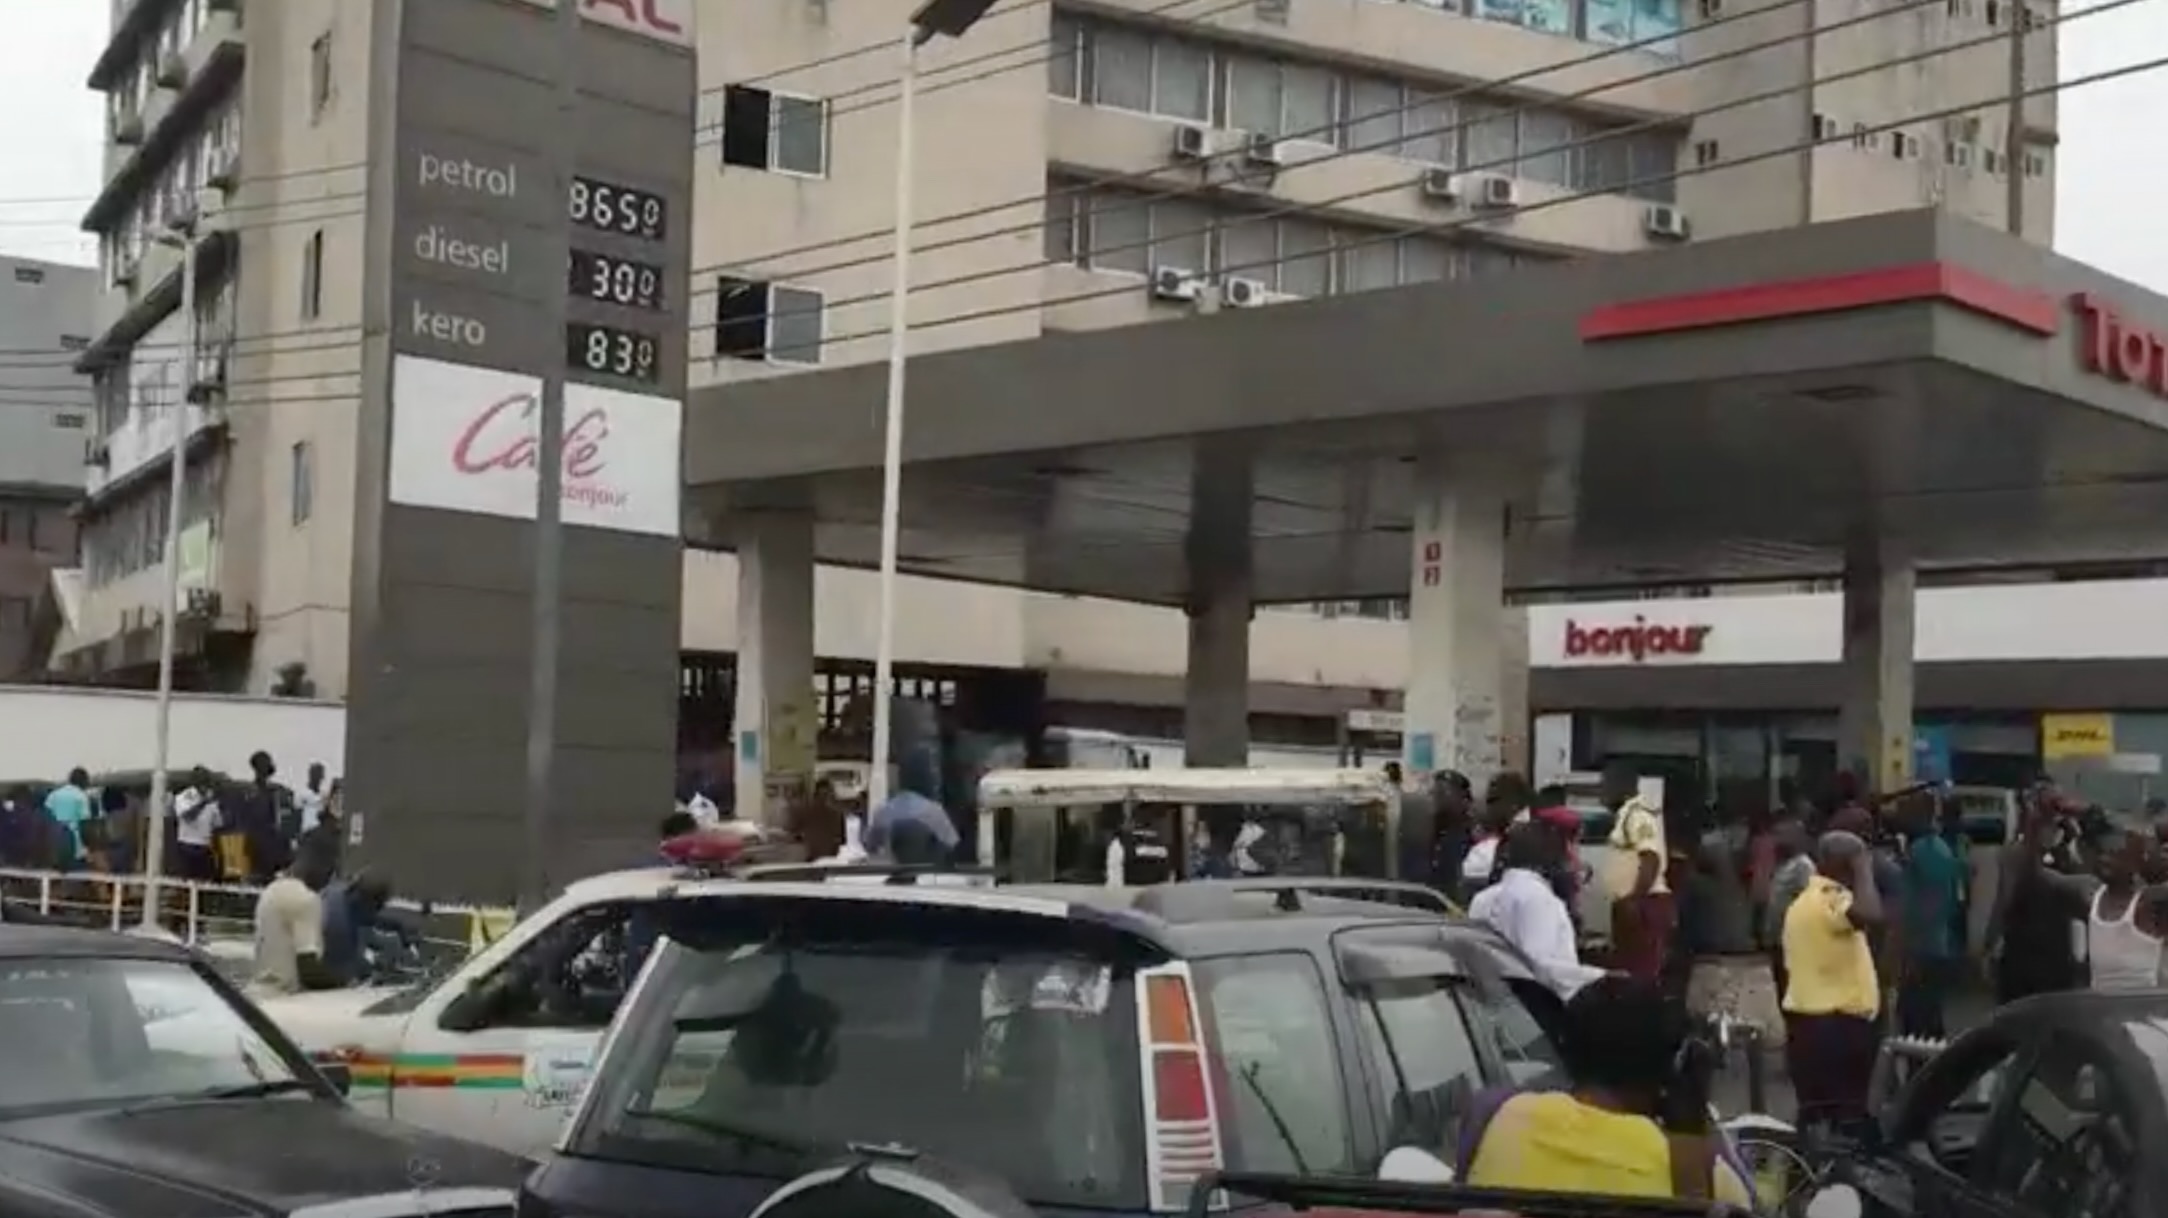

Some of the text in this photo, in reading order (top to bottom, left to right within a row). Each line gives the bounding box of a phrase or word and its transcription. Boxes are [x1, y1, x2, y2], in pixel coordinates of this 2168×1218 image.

[418, 154, 517, 197] petrol
[415, 225, 509, 273] diesel
[412, 301, 486, 346] kero
[560, 483, 631, 511] onjour
[1565, 614, 1713, 662] bonjour
